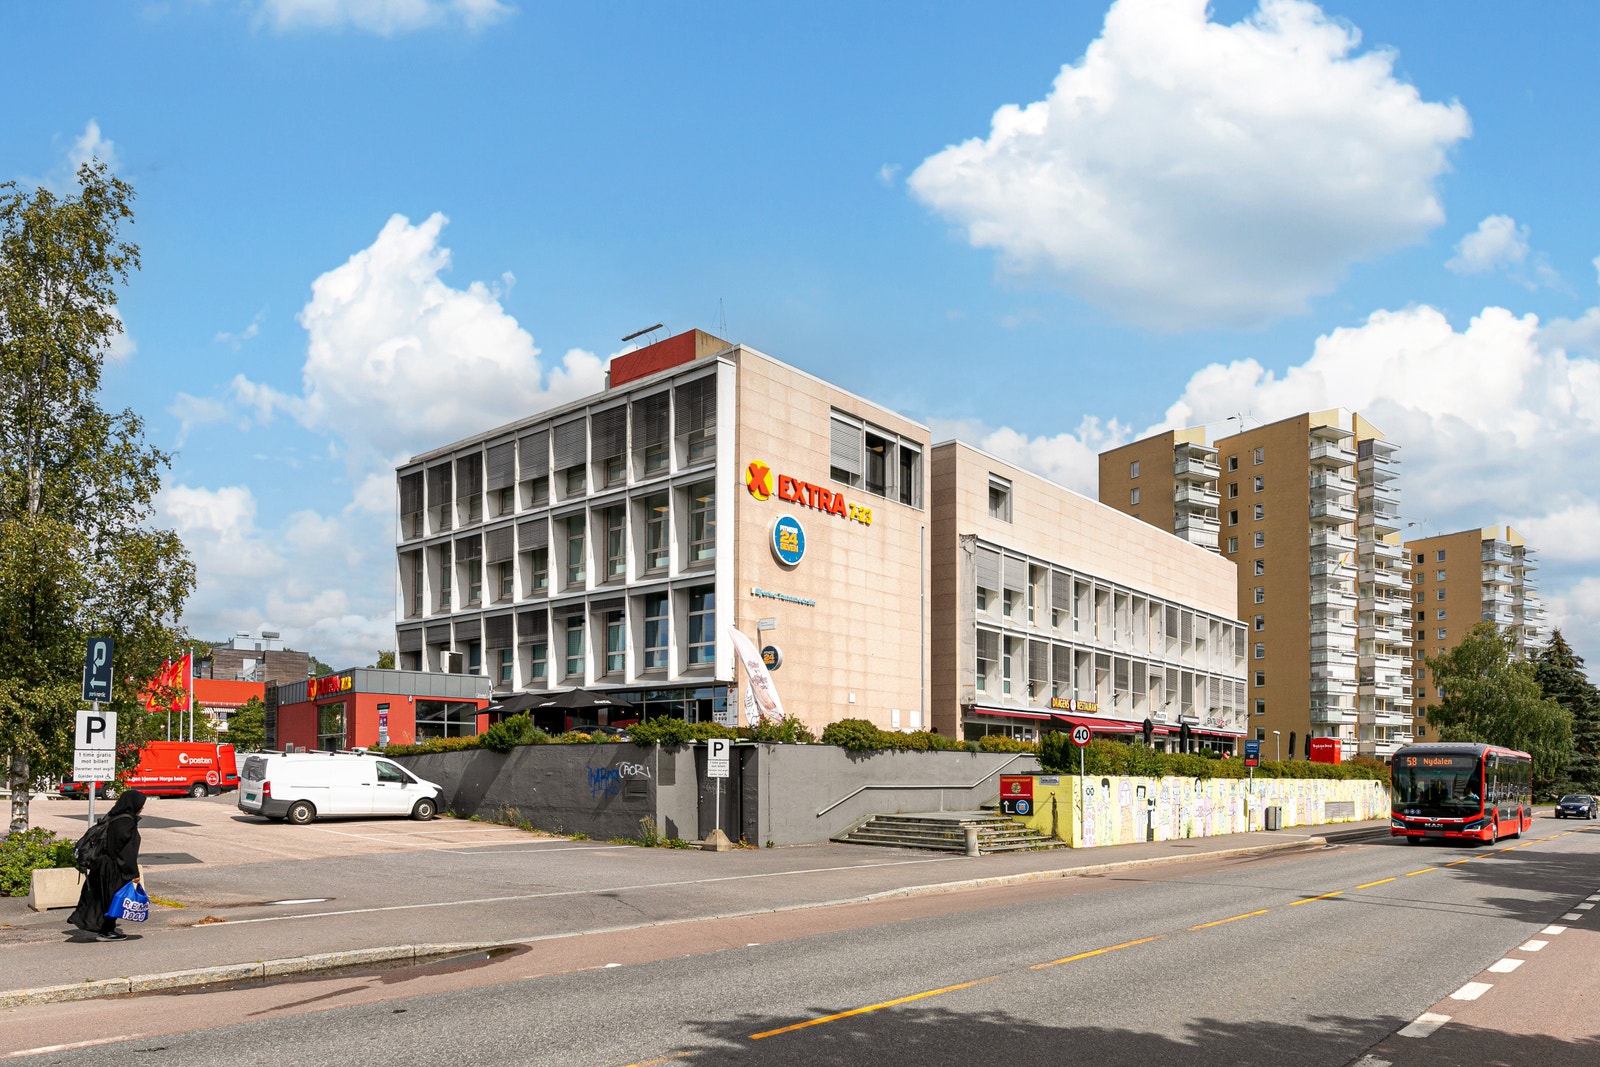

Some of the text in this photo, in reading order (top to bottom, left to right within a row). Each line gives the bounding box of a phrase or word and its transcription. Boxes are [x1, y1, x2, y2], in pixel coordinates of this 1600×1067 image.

[778, 474, 847, 518] EXTRA
[849, 503, 873, 525] 7-23
[780, 531, 799, 545] 24
[780, 543, 799, 553] SEVEN
[763, 654, 775, 662] 24
[1052, 698, 1070, 709] DRAGENS
[85, 716, 106, 745] P
[1074, 729, 1089, 741] 40
[713, 741, 724, 757] P
[189, 756, 213, 765] posten
[1406, 756, 1453, 767] 58 Nydalen
[142, 775, 159, 783] kjenner
[123, 909, 146, 922] 1000
